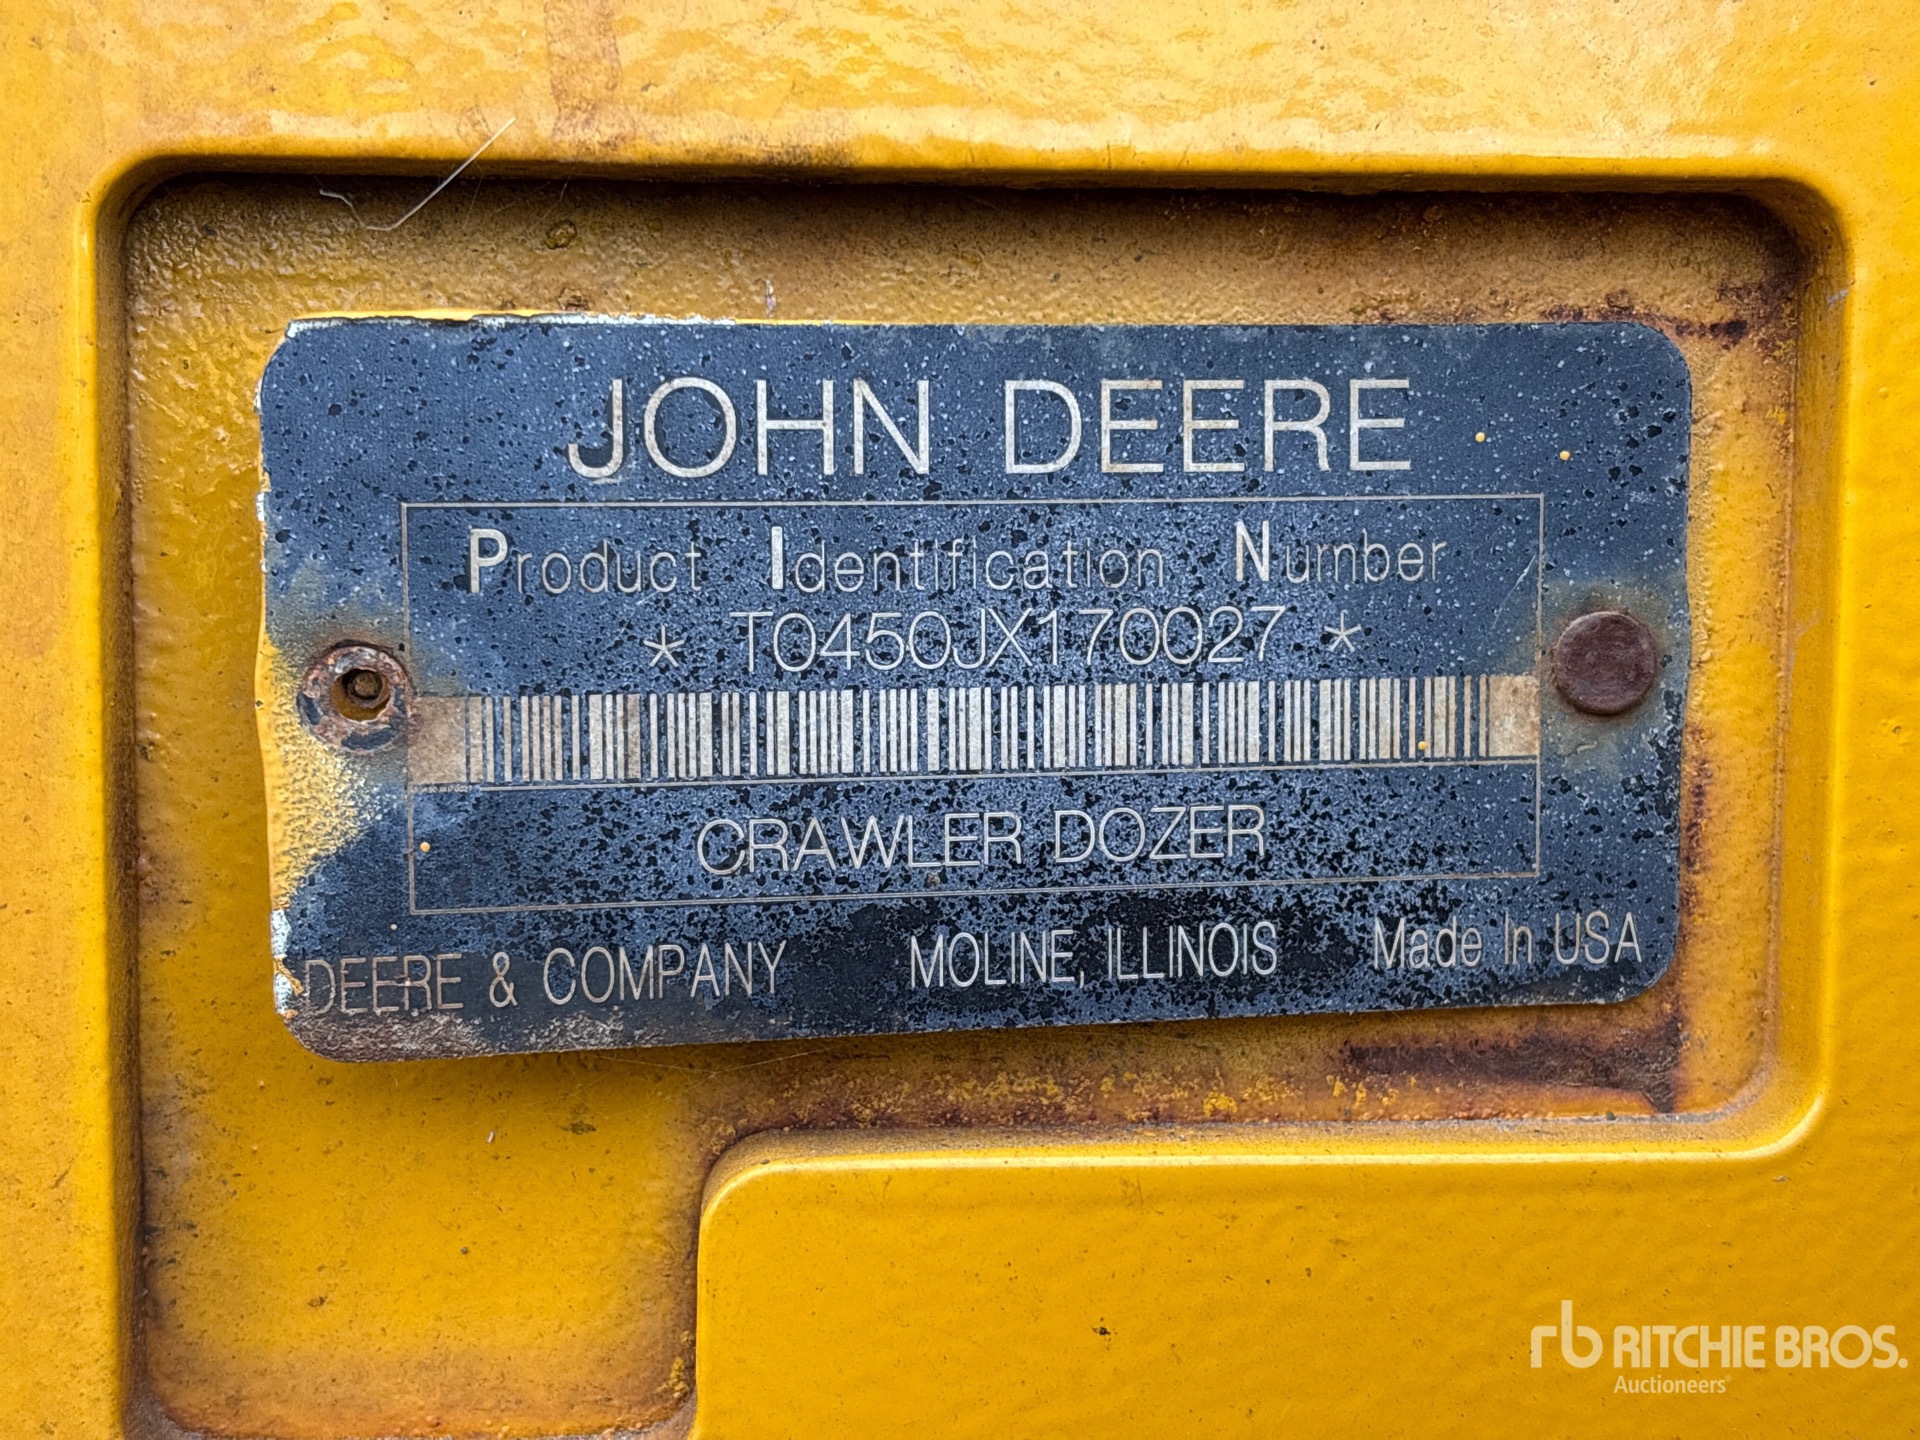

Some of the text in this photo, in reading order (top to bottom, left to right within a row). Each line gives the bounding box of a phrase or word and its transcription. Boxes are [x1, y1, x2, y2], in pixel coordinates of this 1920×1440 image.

[567, 376, 1412, 482] JOHN DEERE
[468, 519, 1447, 596] Product Identification Number
[731, 604, 1287, 674] T0450JX170027
[697, 804, 1266, 876] CRAWLER DOZER
[304, 910, 1644, 1015] DEERE & COMPANY MOLINE, ILLINOIS Made In USA
